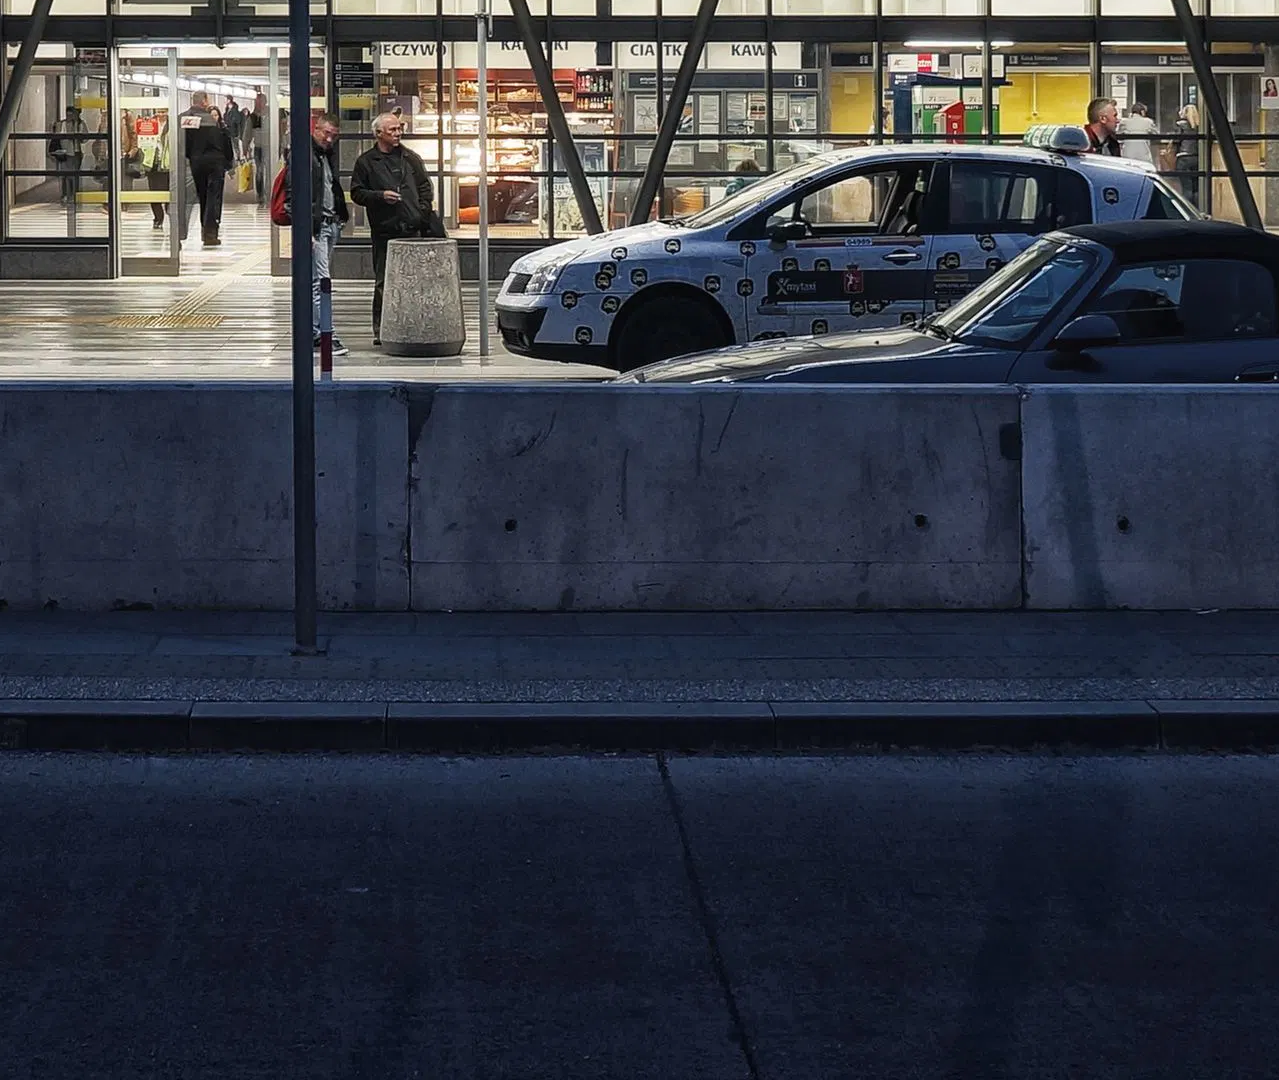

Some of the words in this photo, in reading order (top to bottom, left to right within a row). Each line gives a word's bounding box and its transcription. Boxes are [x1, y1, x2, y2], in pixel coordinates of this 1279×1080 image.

[369, 44, 447, 56] PIECZYWO
[501, 41, 569, 51] KAKI
[630, 44, 684, 56] CIATK
